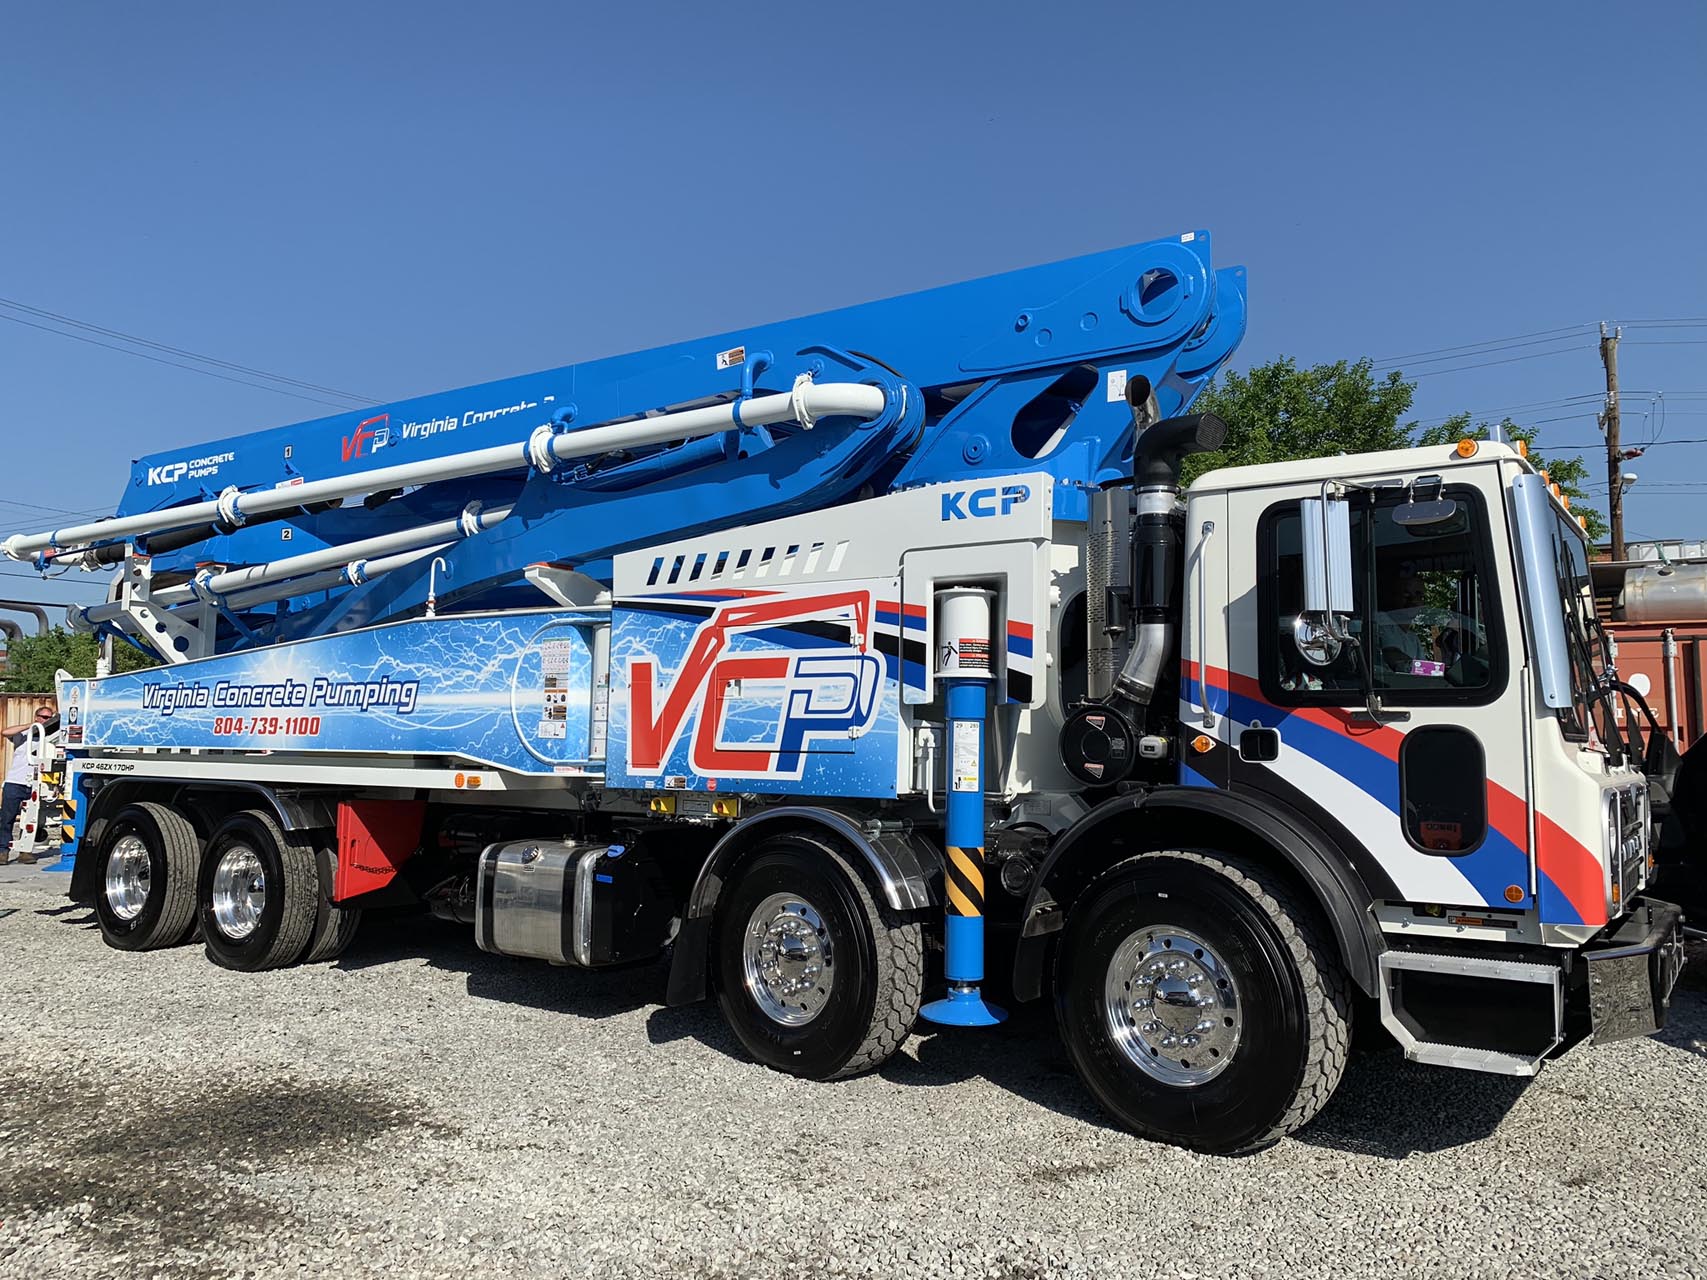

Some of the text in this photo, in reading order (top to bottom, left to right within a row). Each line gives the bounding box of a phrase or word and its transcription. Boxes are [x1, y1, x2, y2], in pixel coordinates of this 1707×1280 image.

[402, 416, 458, 440] Virginia
[147, 452, 235, 486] KCP CONCRETE
[188, 465, 219, 480] PUMPS
[941, 484, 1031, 521] KCP
[142, 675, 420, 716] Virginia Concrete Pumping
[627, 588, 884, 776] VCP
[213, 716, 321, 737] 804-739-1100
[81, 762, 95, 770] KCP
[113, 763, 135, 772] 170HP
